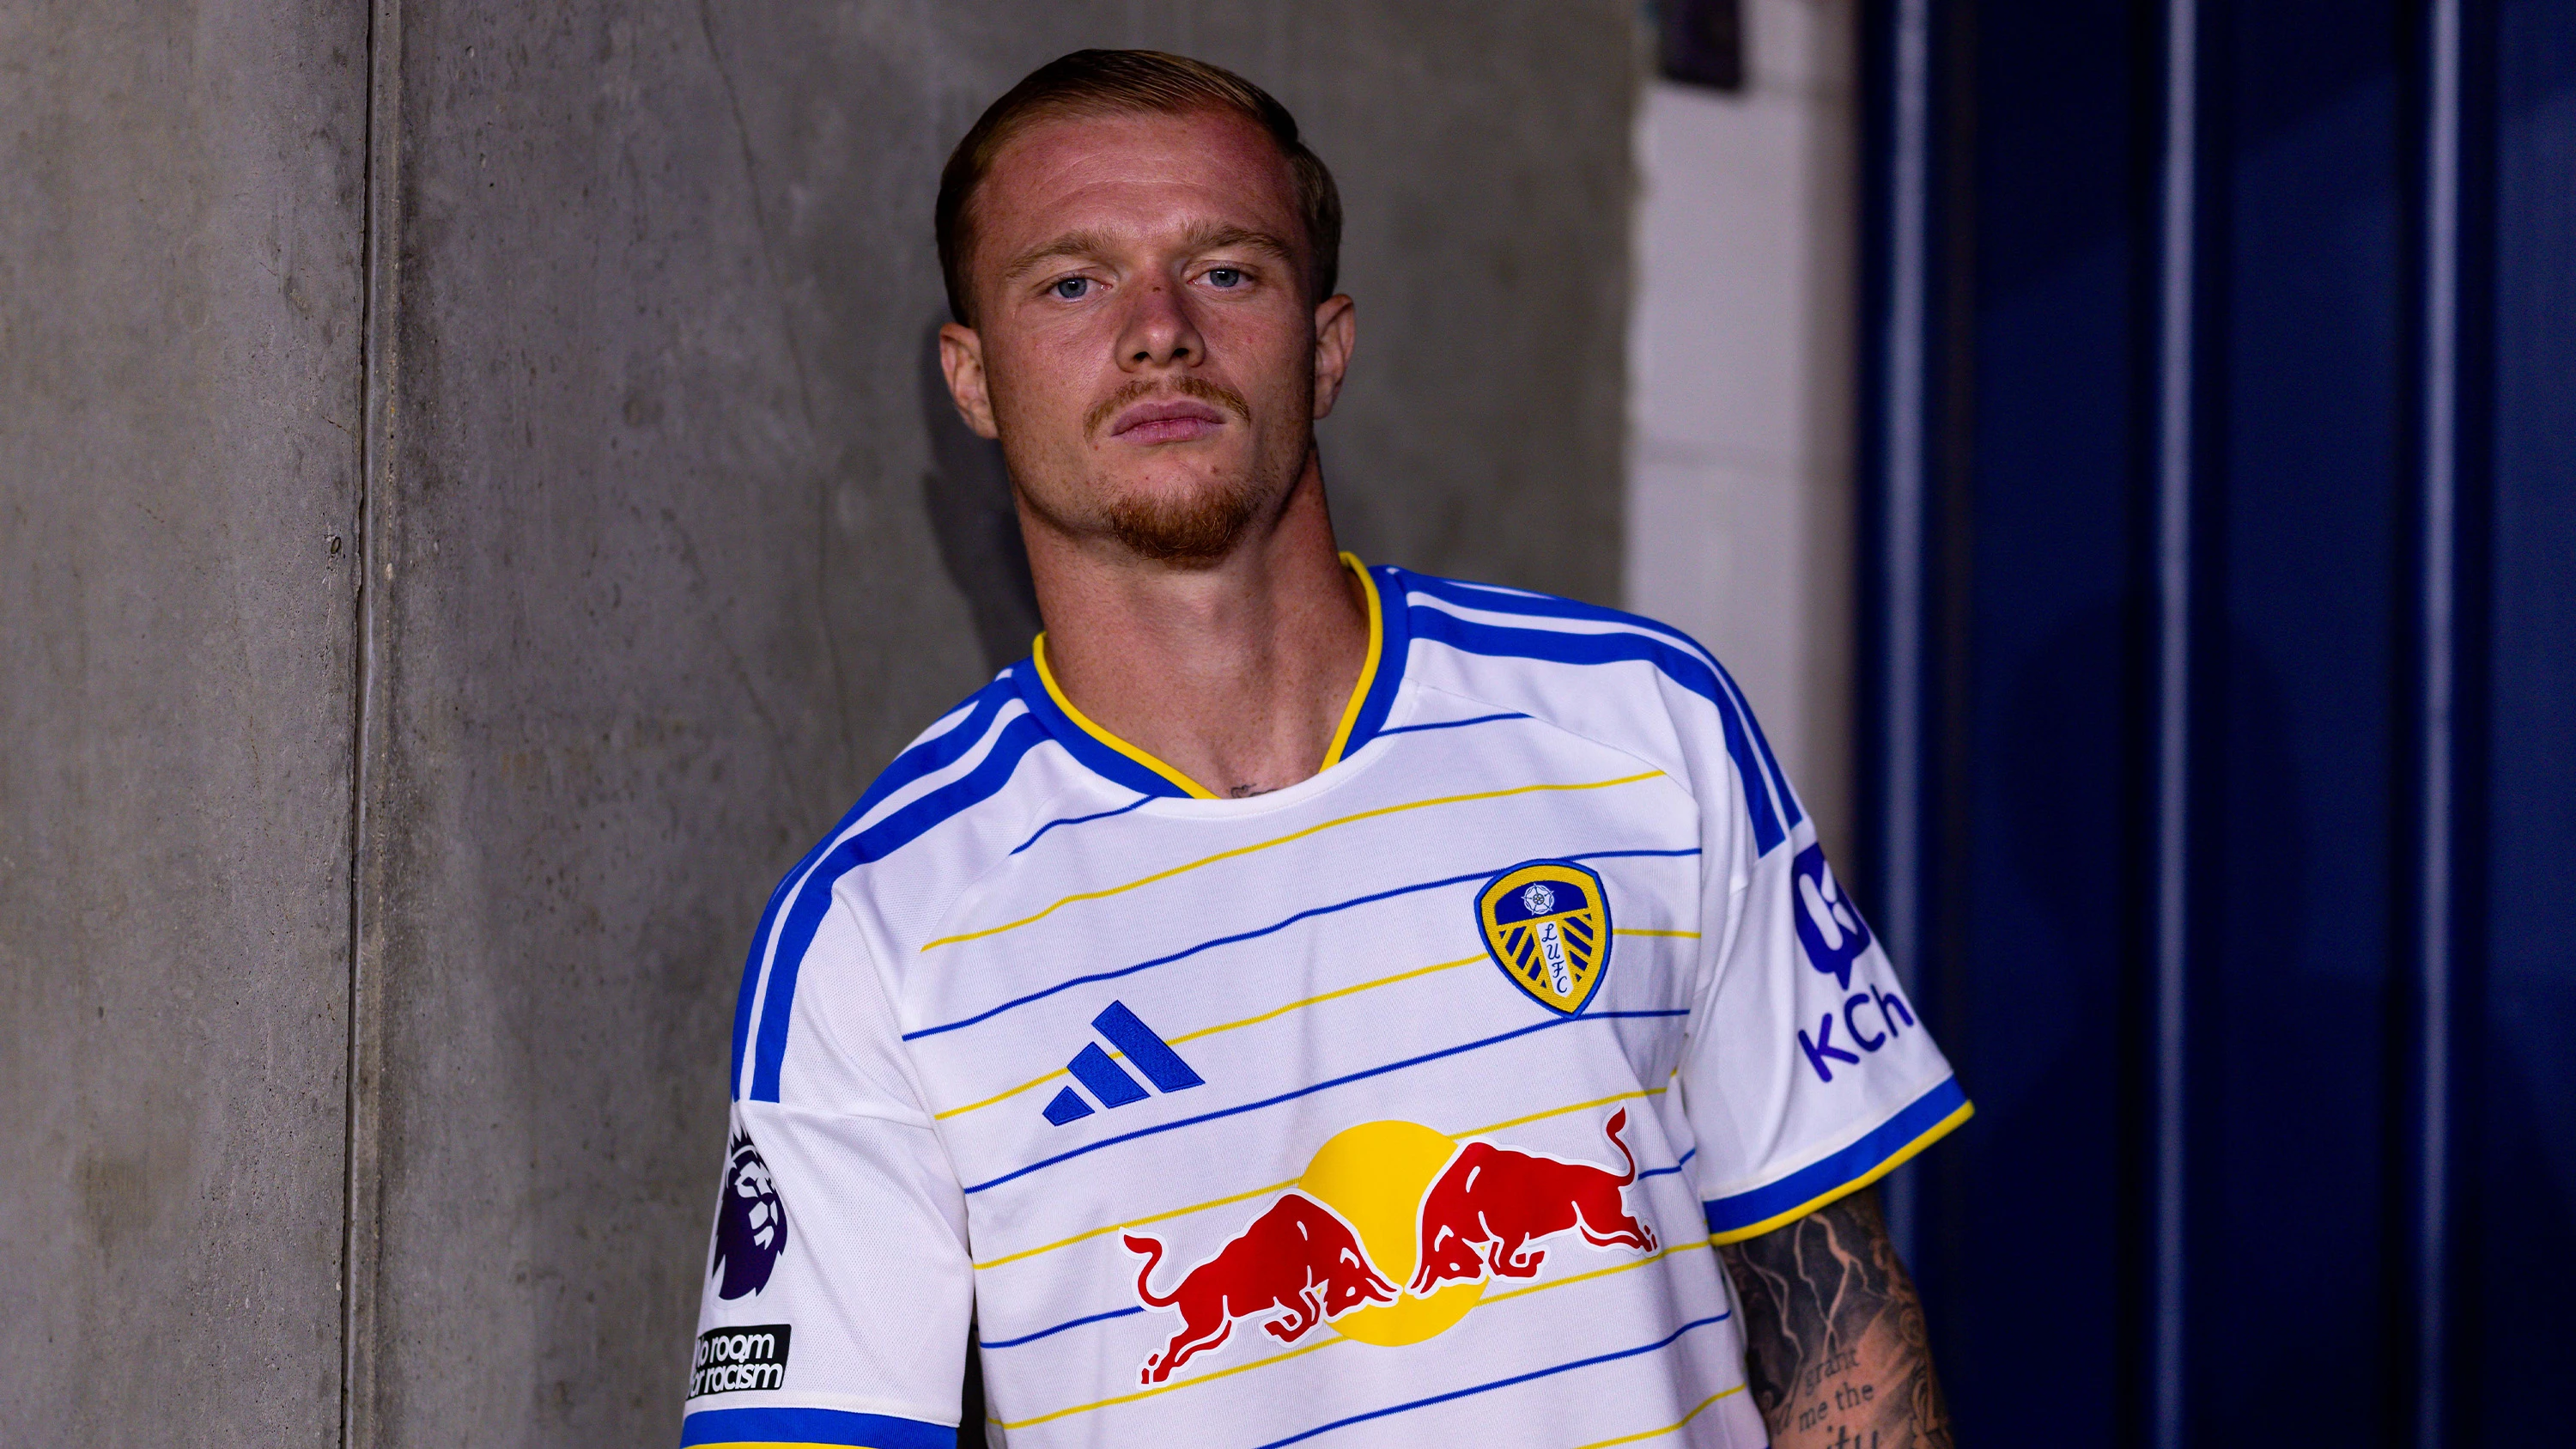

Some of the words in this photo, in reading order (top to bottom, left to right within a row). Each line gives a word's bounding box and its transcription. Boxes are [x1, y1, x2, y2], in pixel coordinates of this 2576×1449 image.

[1541, 922, 1569, 994] LUFC
[709, 1333, 775, 1364] room
[704, 1360, 783, 1393] racism
[1806, 1349, 1860, 1396] grant
[1799, 1401, 1828, 1433] me
[1835, 1381, 1874, 1411] the
